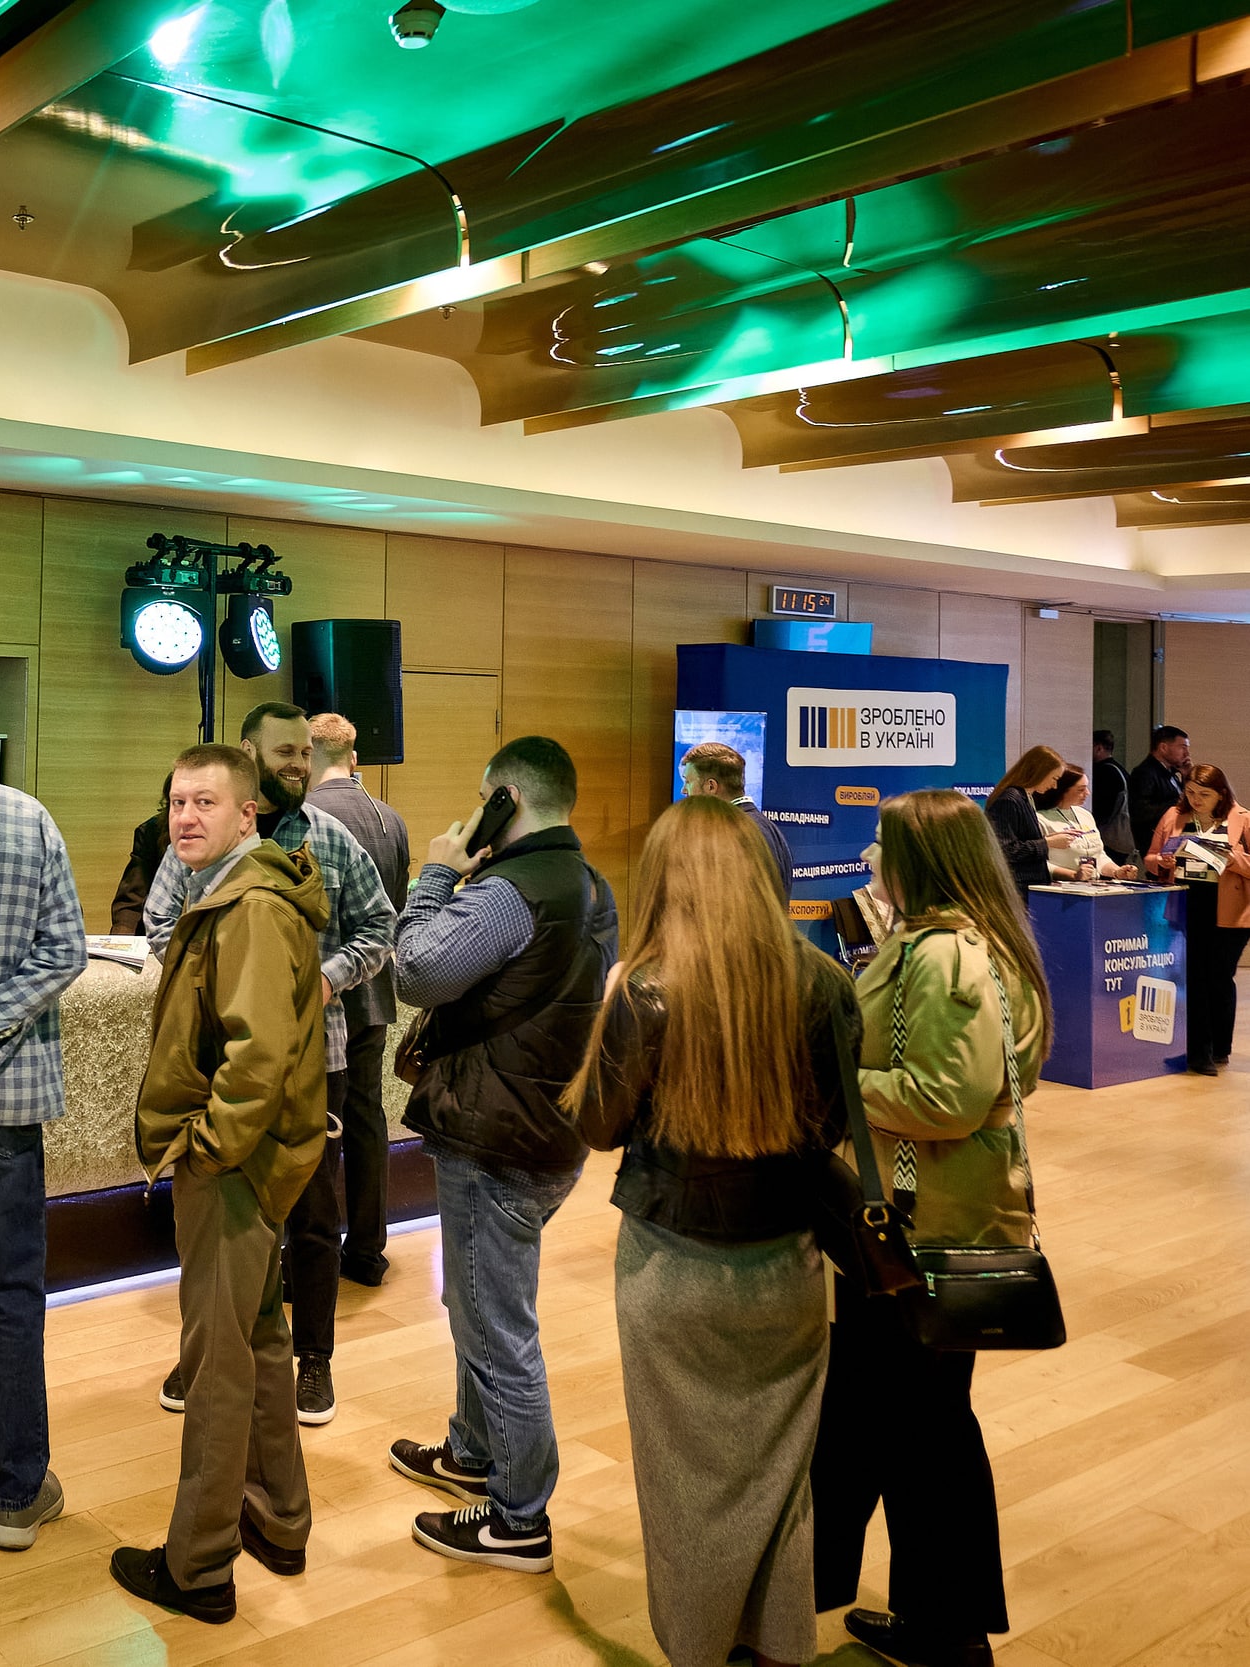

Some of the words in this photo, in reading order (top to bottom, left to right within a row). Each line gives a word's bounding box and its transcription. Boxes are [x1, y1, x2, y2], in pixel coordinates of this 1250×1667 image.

[860, 707, 946, 726] ЗРОБЛЕНО
[860, 731, 871, 749] В
[875, 727, 934, 749] УКРАЇНІ
[839, 790, 876, 801] ВИРОБЛЯЙ
[768, 811, 779, 822] НА
[779, 812, 830, 825] ОБЛАДНАННЯ
[792, 866, 820, 879] НСАЦІЯ
[820, 863, 855, 876] ВАРТОСТІ
[1104, 934, 1148, 954] ОТРИМАЙ
[1105, 952, 1174, 973] КОНСУЛЬТАЦІЮ
[1104, 977, 1123, 992] ТУТ
